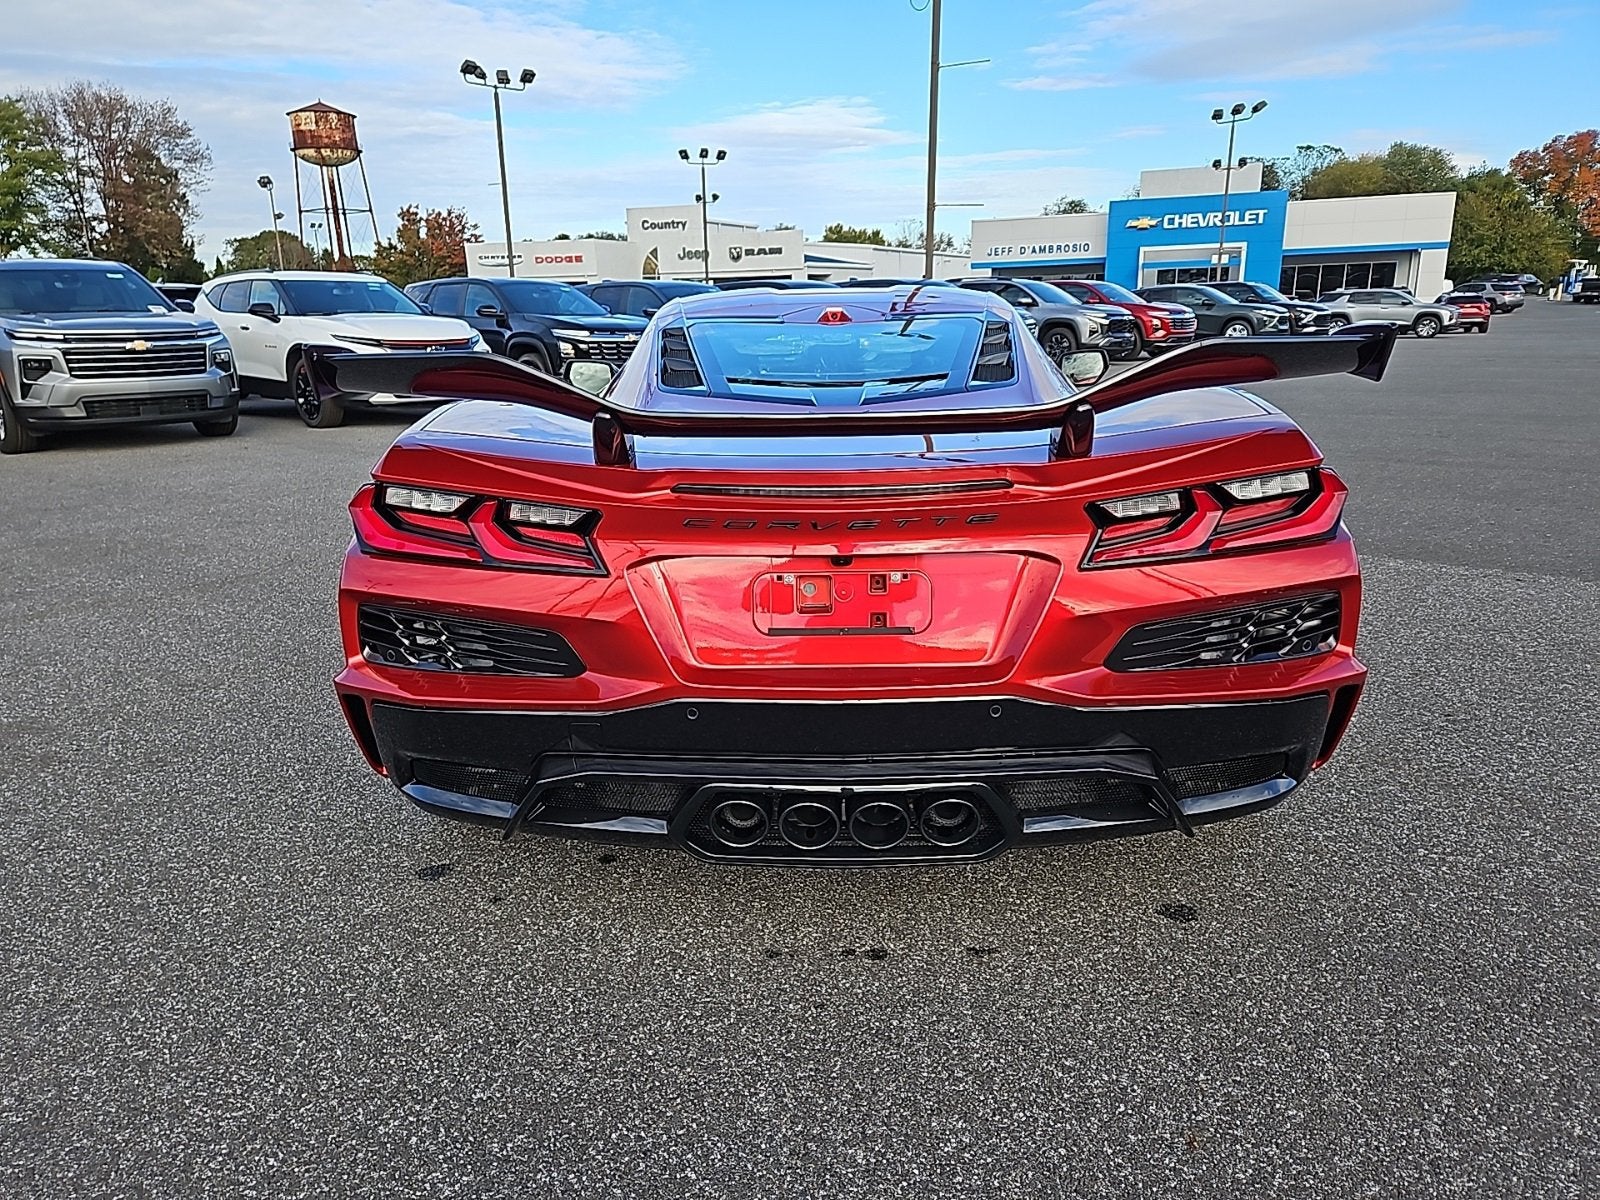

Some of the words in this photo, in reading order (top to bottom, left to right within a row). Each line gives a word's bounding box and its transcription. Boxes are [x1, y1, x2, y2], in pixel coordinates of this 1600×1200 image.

[641, 220, 687, 231] Country
[1163, 209, 1268, 229] CHEVROLET
[678, 247, 709, 261] Jeep
[744, 247, 783, 256] RAM
[987, 247, 1013, 256] JEFF
[1020, 243, 1090, 255] D'AMBROSIO
[534, 255, 583, 264] DODGE
[682, 513, 1000, 531] CORVETTE
